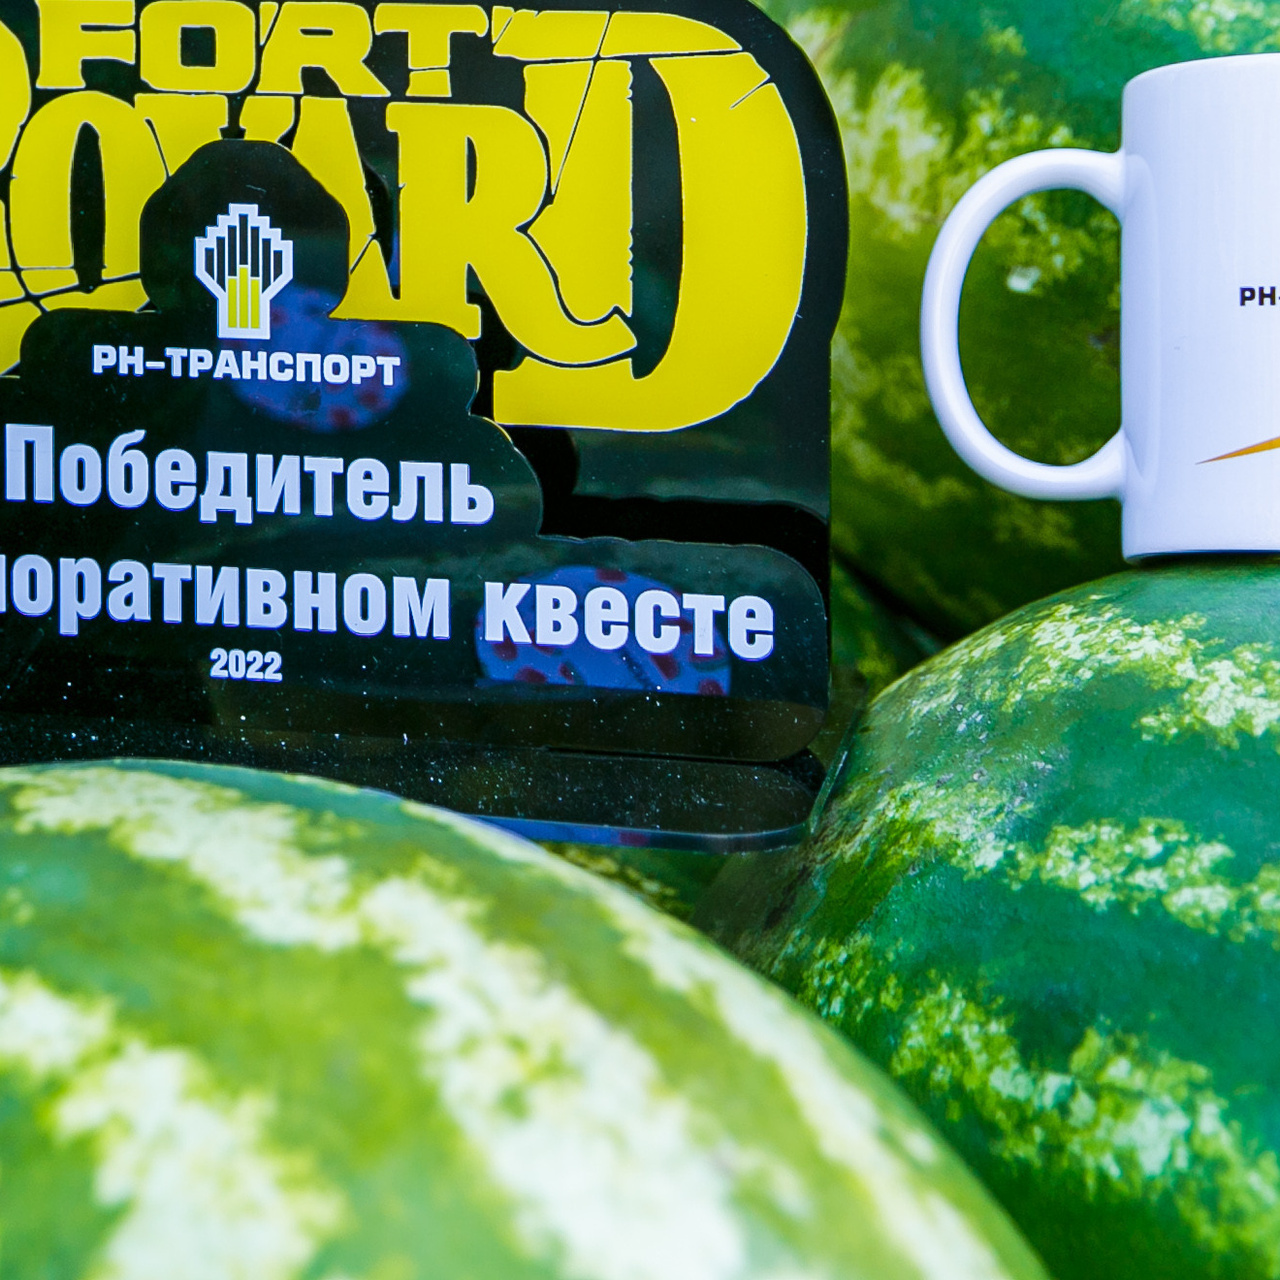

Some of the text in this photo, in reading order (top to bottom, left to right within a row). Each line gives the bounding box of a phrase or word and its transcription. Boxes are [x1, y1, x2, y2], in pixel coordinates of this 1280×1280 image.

[1239, 286, 1280, 306] РН
[93, 344, 401, 386] РН-ТРАНСПОРТ
[5, 423, 494, 525] Победитель
[483, 580, 775, 660] квесте
[209, 647, 283, 682] 2022
